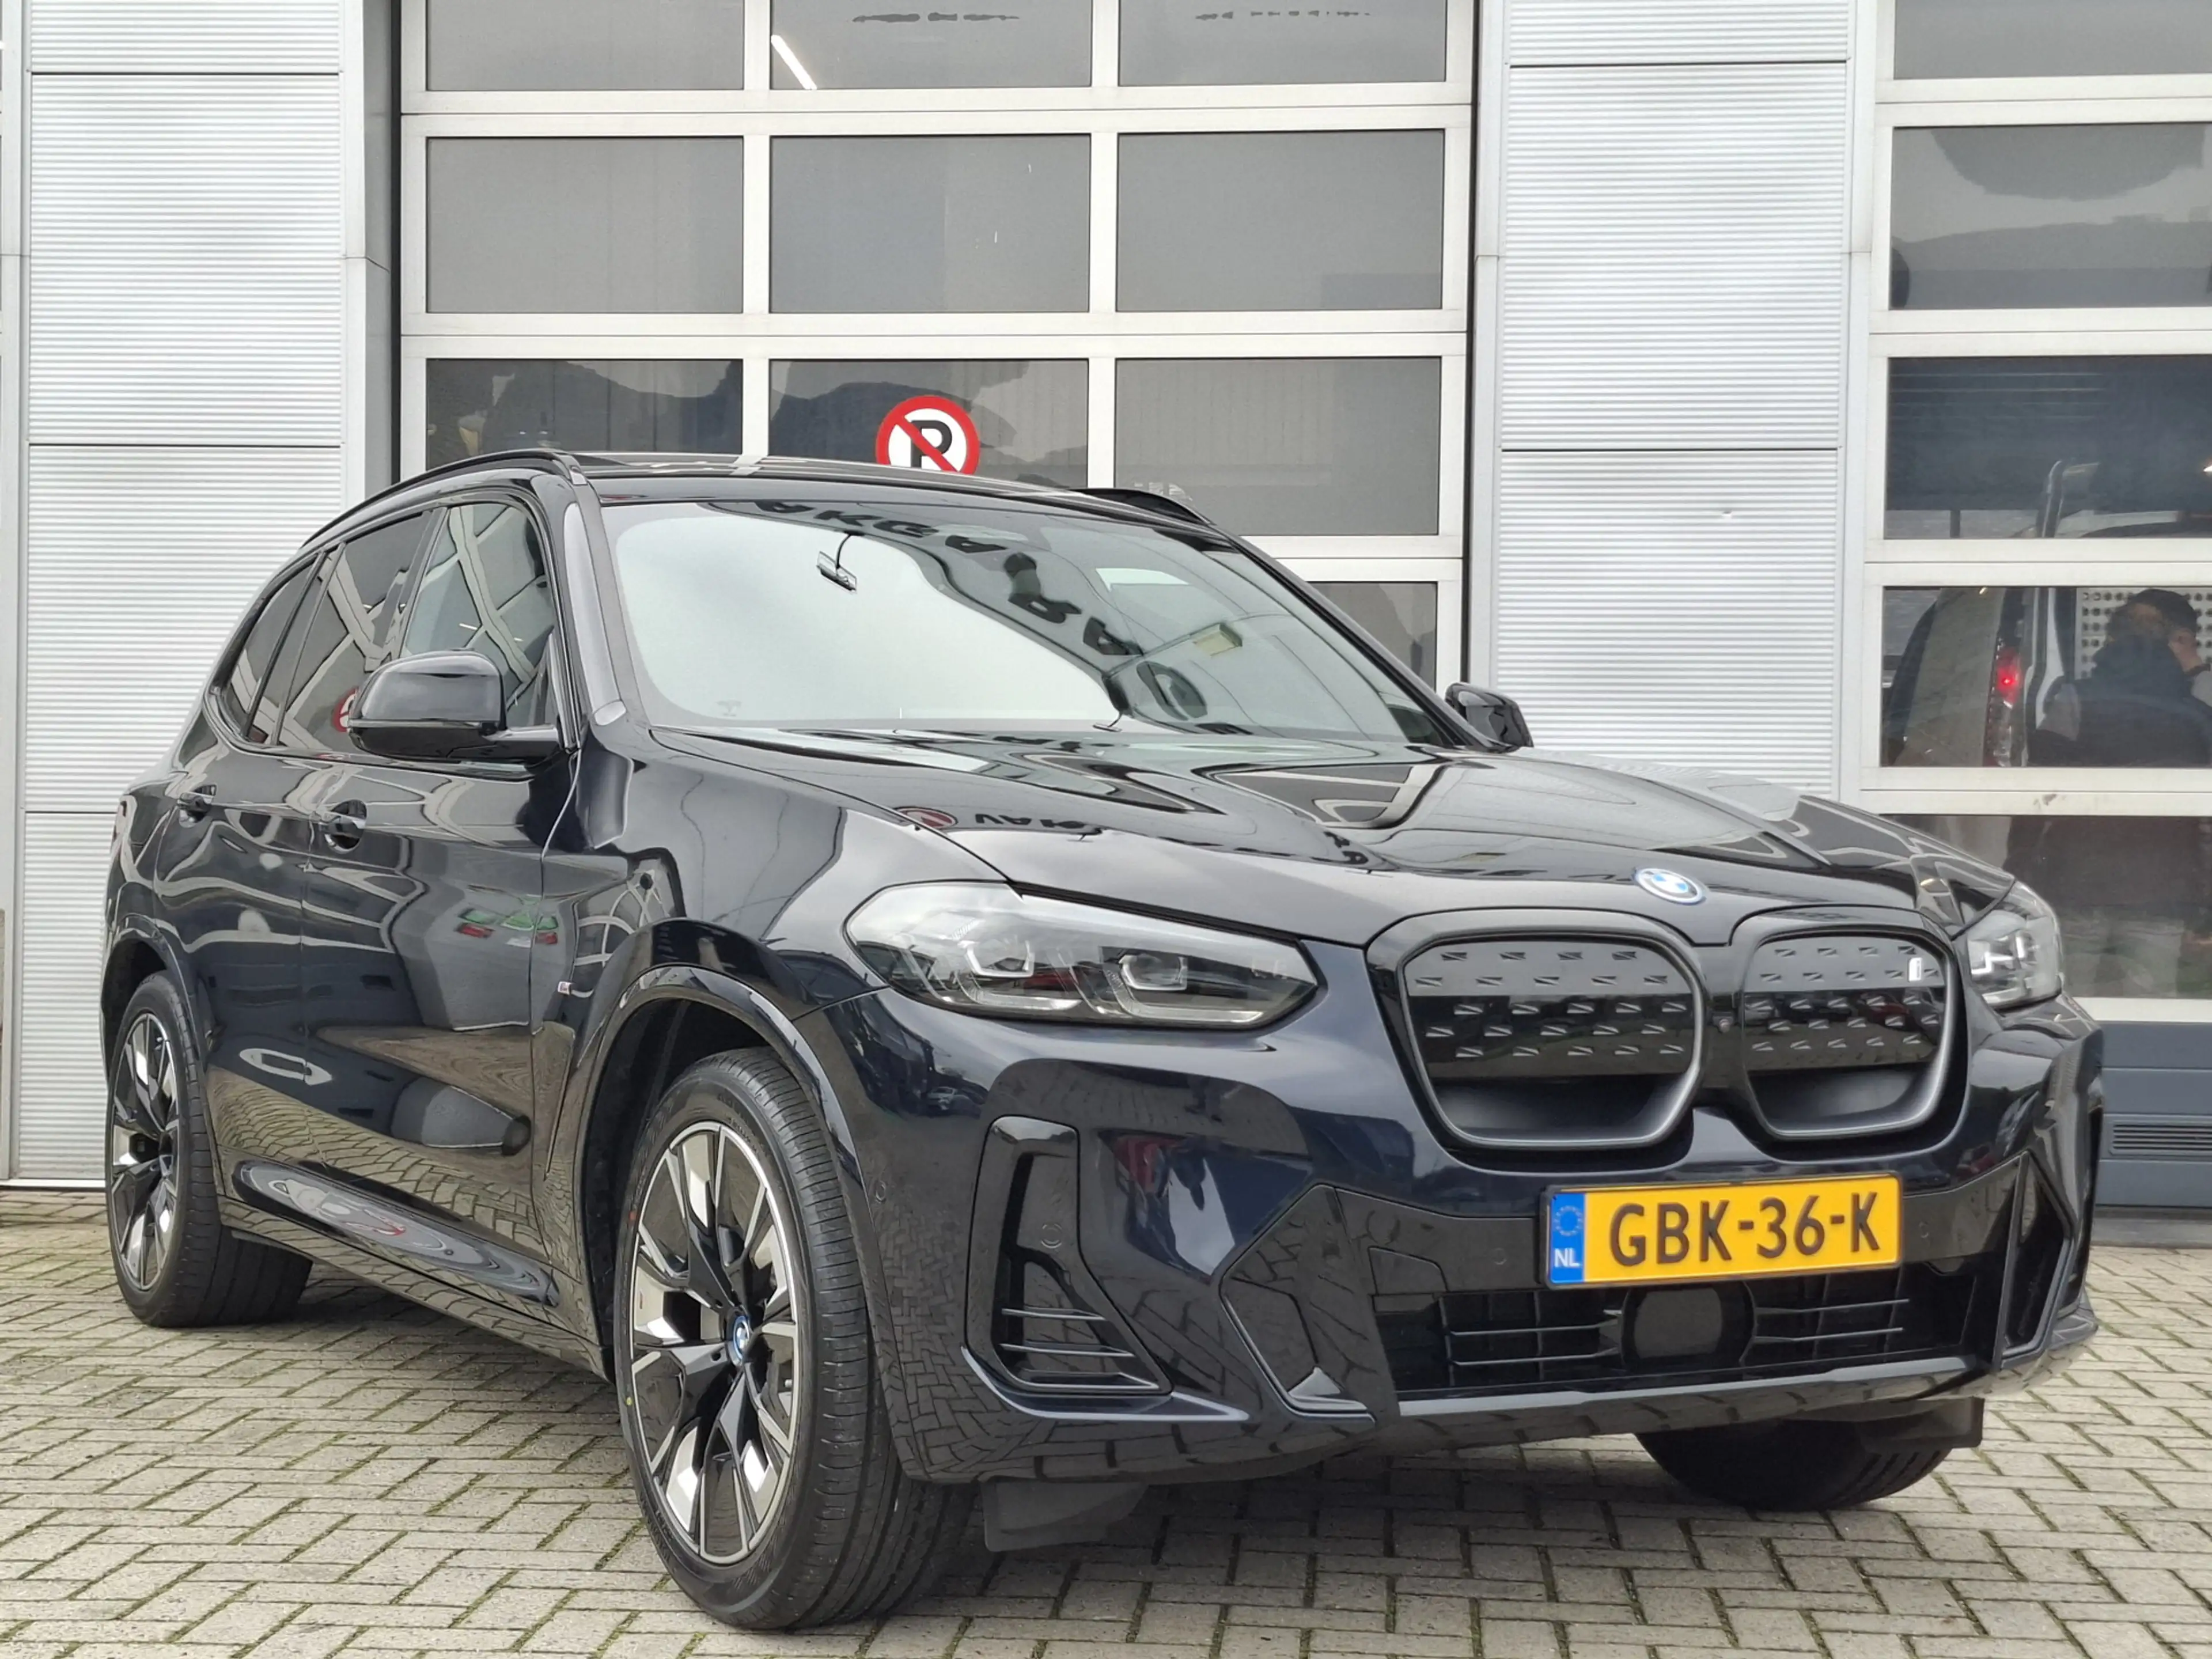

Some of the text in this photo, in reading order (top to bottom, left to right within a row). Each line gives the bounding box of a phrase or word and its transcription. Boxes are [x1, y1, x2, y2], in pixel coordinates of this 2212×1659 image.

[911, 420, 952, 469] P
[1609, 1192, 1880, 1267] GBK-36-K
[1554, 1247, 1581, 1267] NL
